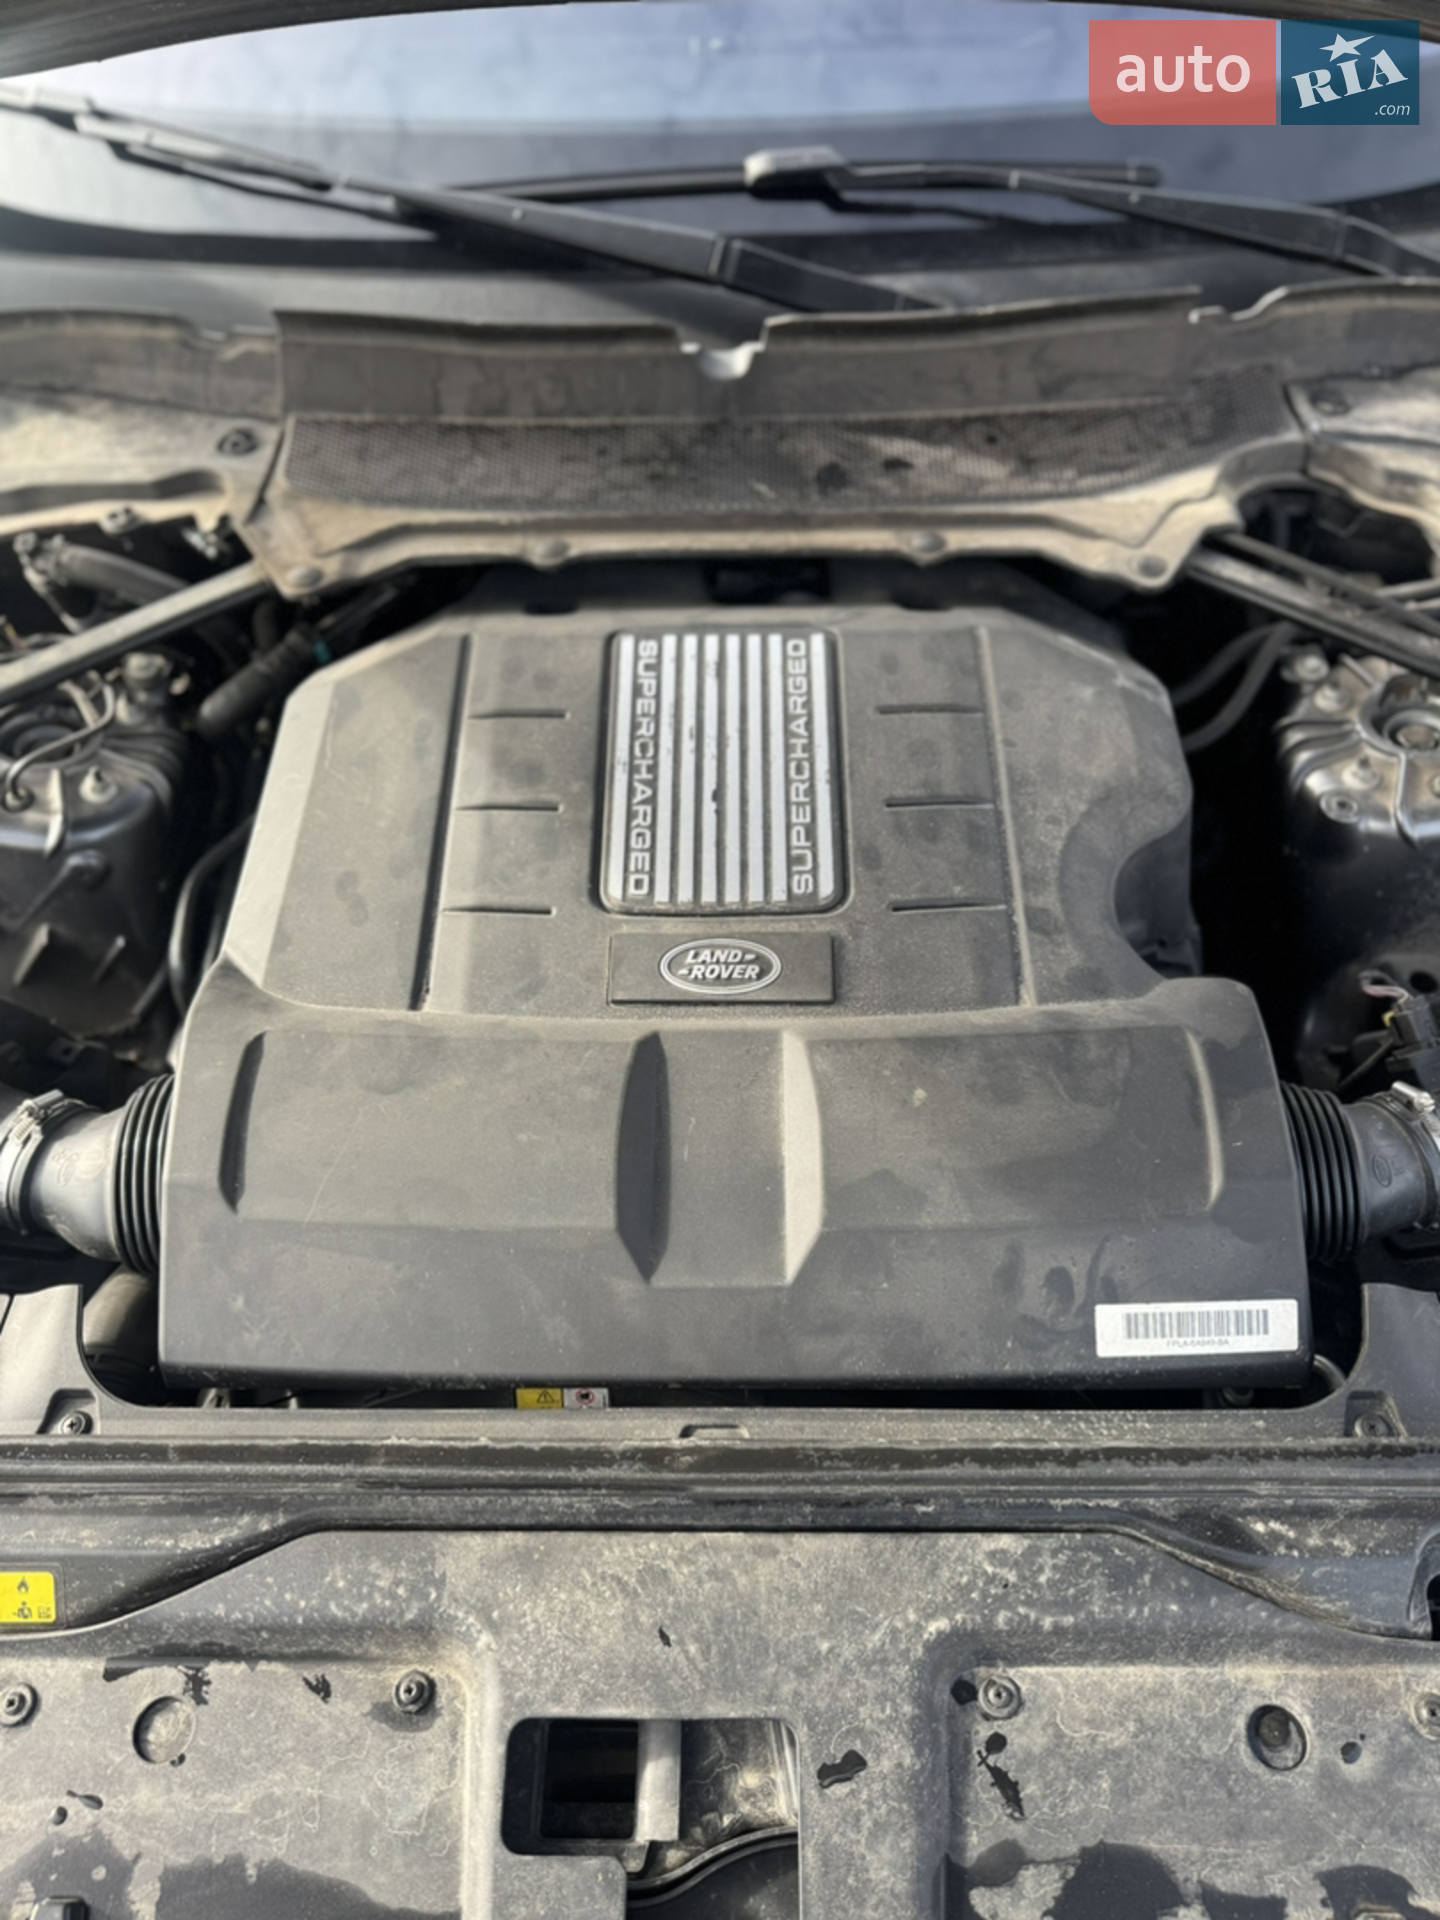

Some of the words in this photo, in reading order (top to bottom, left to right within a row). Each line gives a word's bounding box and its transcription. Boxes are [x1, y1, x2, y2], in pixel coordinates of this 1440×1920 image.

[628, 639, 658, 896] SUPERCHARGED
[786, 638, 813, 894] SUPERCHARGED
[685, 949, 743, 964] LAND
[689, 964, 760, 979] ROVER
